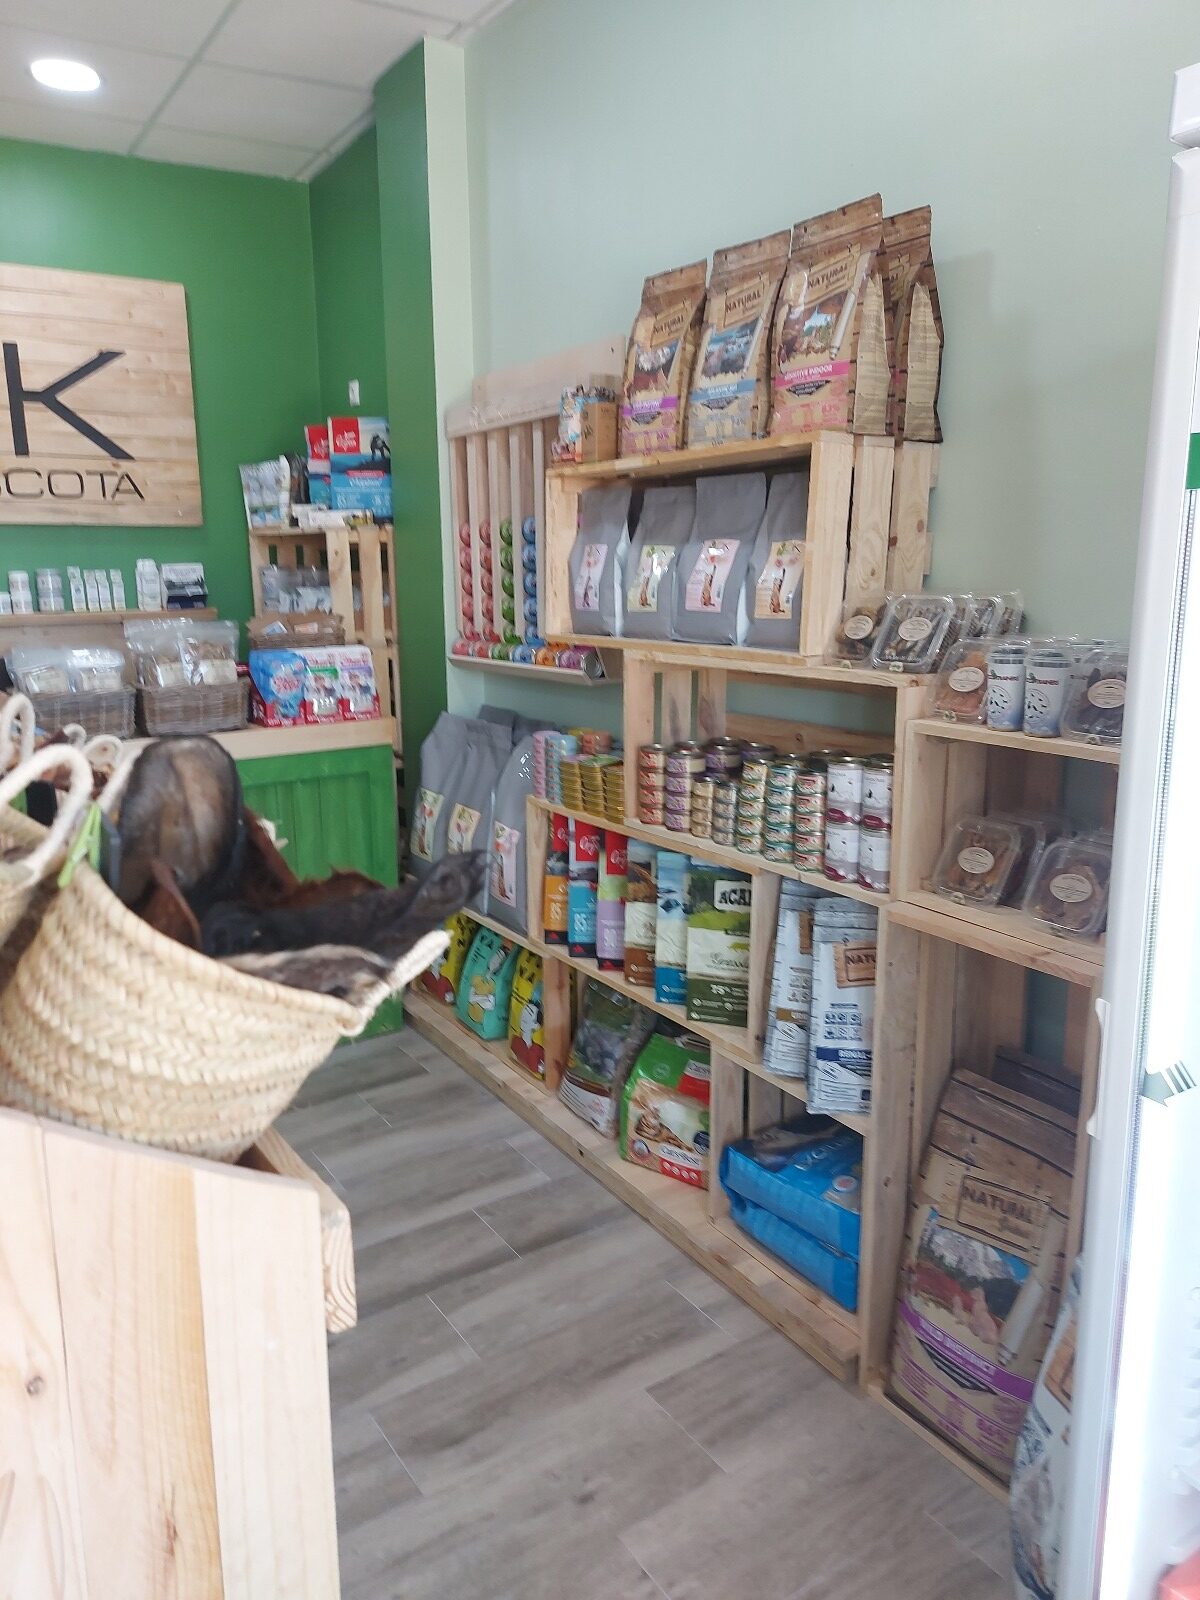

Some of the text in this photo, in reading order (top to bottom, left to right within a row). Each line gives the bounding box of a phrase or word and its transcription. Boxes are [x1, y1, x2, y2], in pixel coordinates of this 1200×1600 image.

[725, 289, 762, 313] NATURAL
[3, 342, 136, 460] K
[0, 468, 145, 501] COTA
